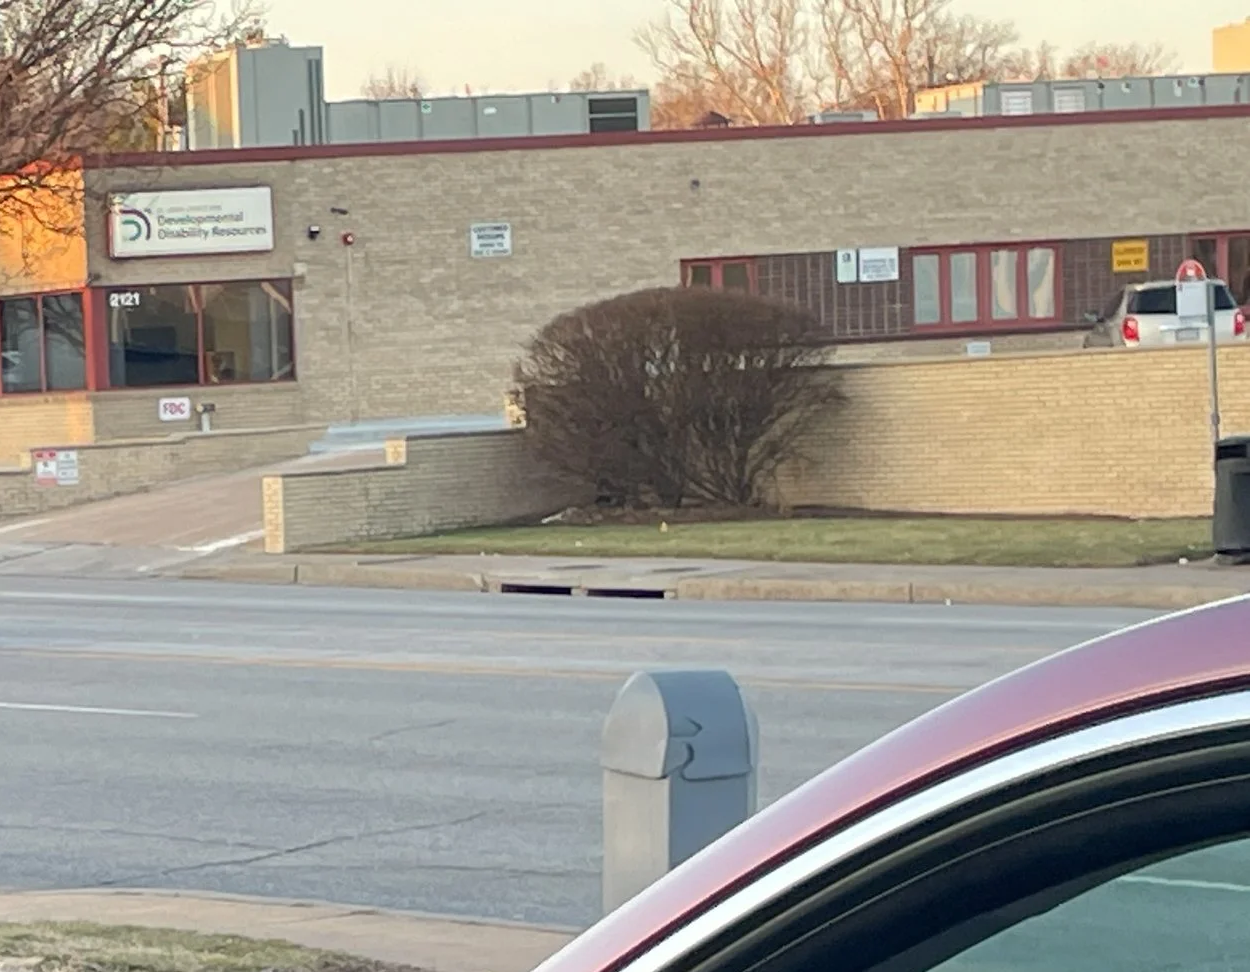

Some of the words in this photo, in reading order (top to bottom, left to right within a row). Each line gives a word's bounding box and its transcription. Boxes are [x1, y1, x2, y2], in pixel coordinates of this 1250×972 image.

[158, 212, 244, 226] Developmental
[158, 228, 209, 240] Disability
[212, 225, 267, 237] Resources
[109, 292, 140, 307] 2121
[163, 402, 186, 415] FDC
